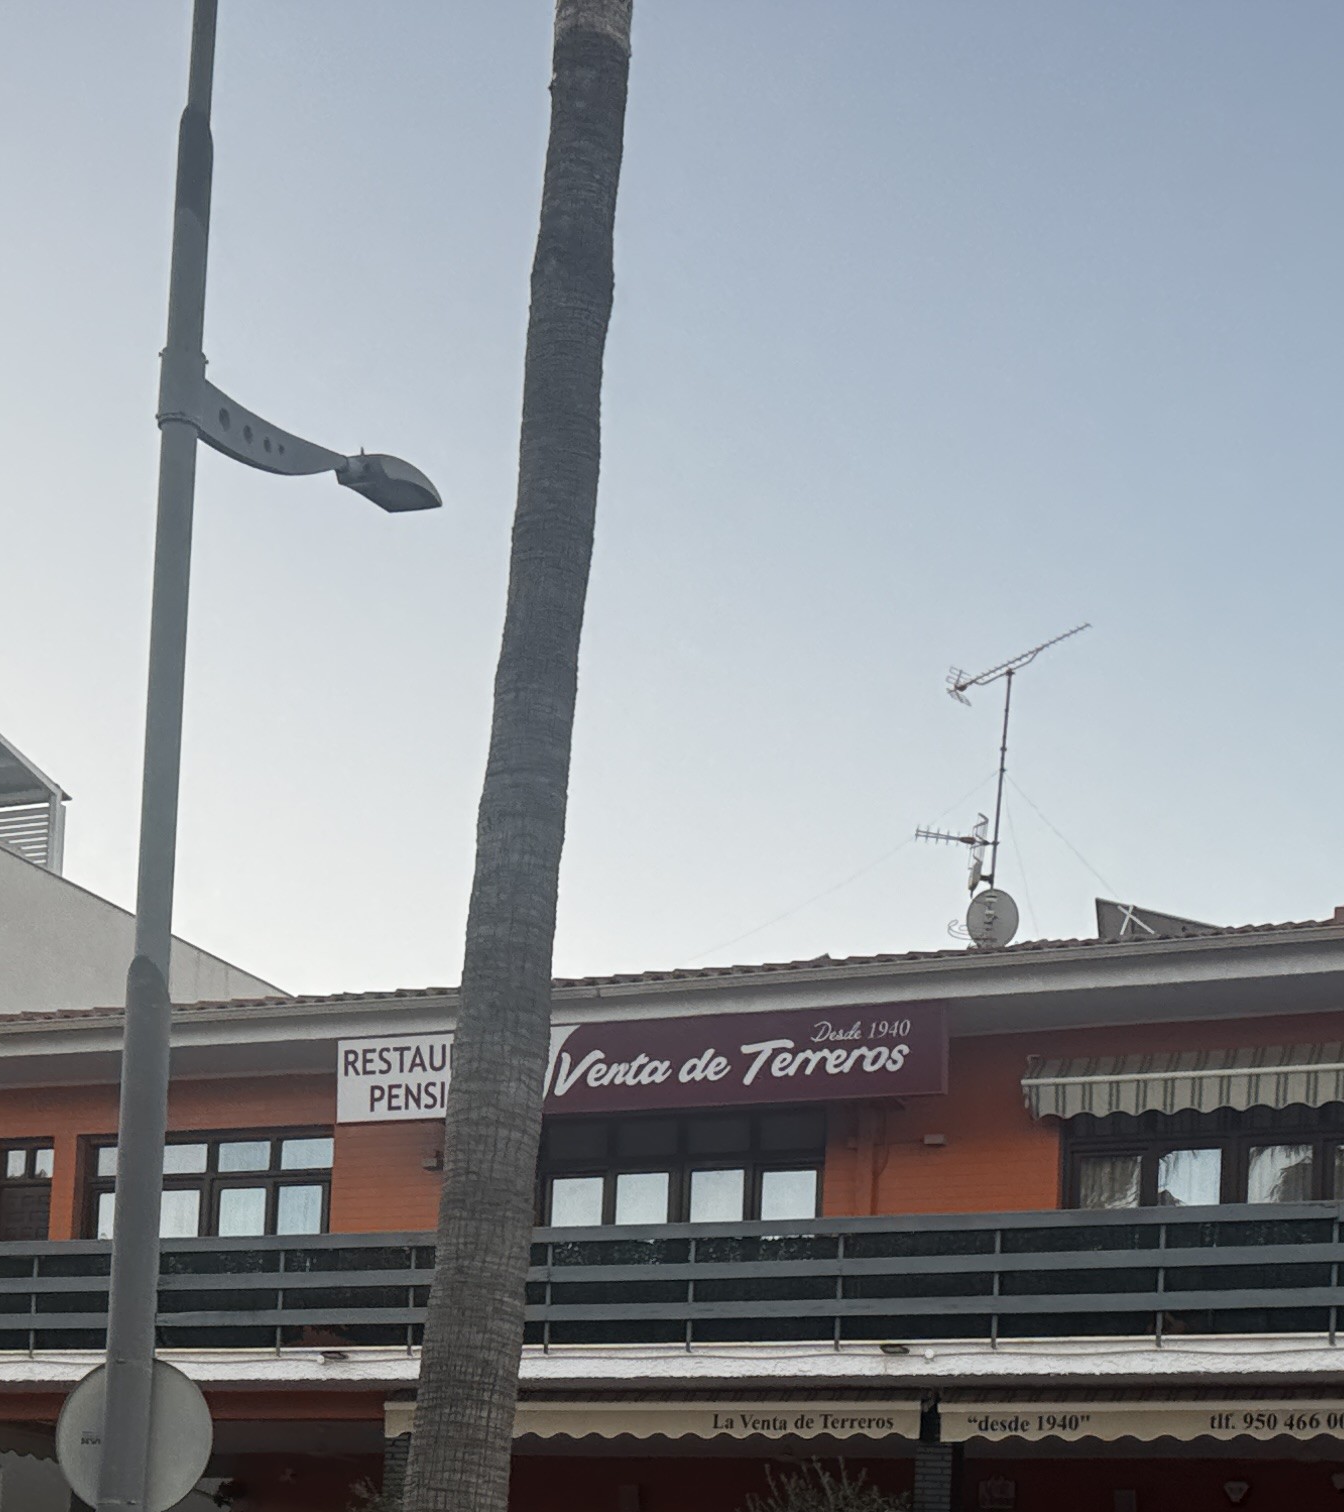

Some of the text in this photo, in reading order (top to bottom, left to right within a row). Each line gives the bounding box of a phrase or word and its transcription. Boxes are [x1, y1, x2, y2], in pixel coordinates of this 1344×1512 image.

[810, 1019, 911, 1043] Desde 1940
[343, 1043, 455, 1077] RESTAU
[554, 1039, 911, 1097] Venta de Terreros
[369, 1081, 446, 1112] PENSI
[712, 1413, 894, 1431] La Venta de Terreros
[1209, 1412, 1236, 1430] tlf.
[1242, 1413, 1277, 1430] 950
[1283, 1412, 1320, 1430] 466
